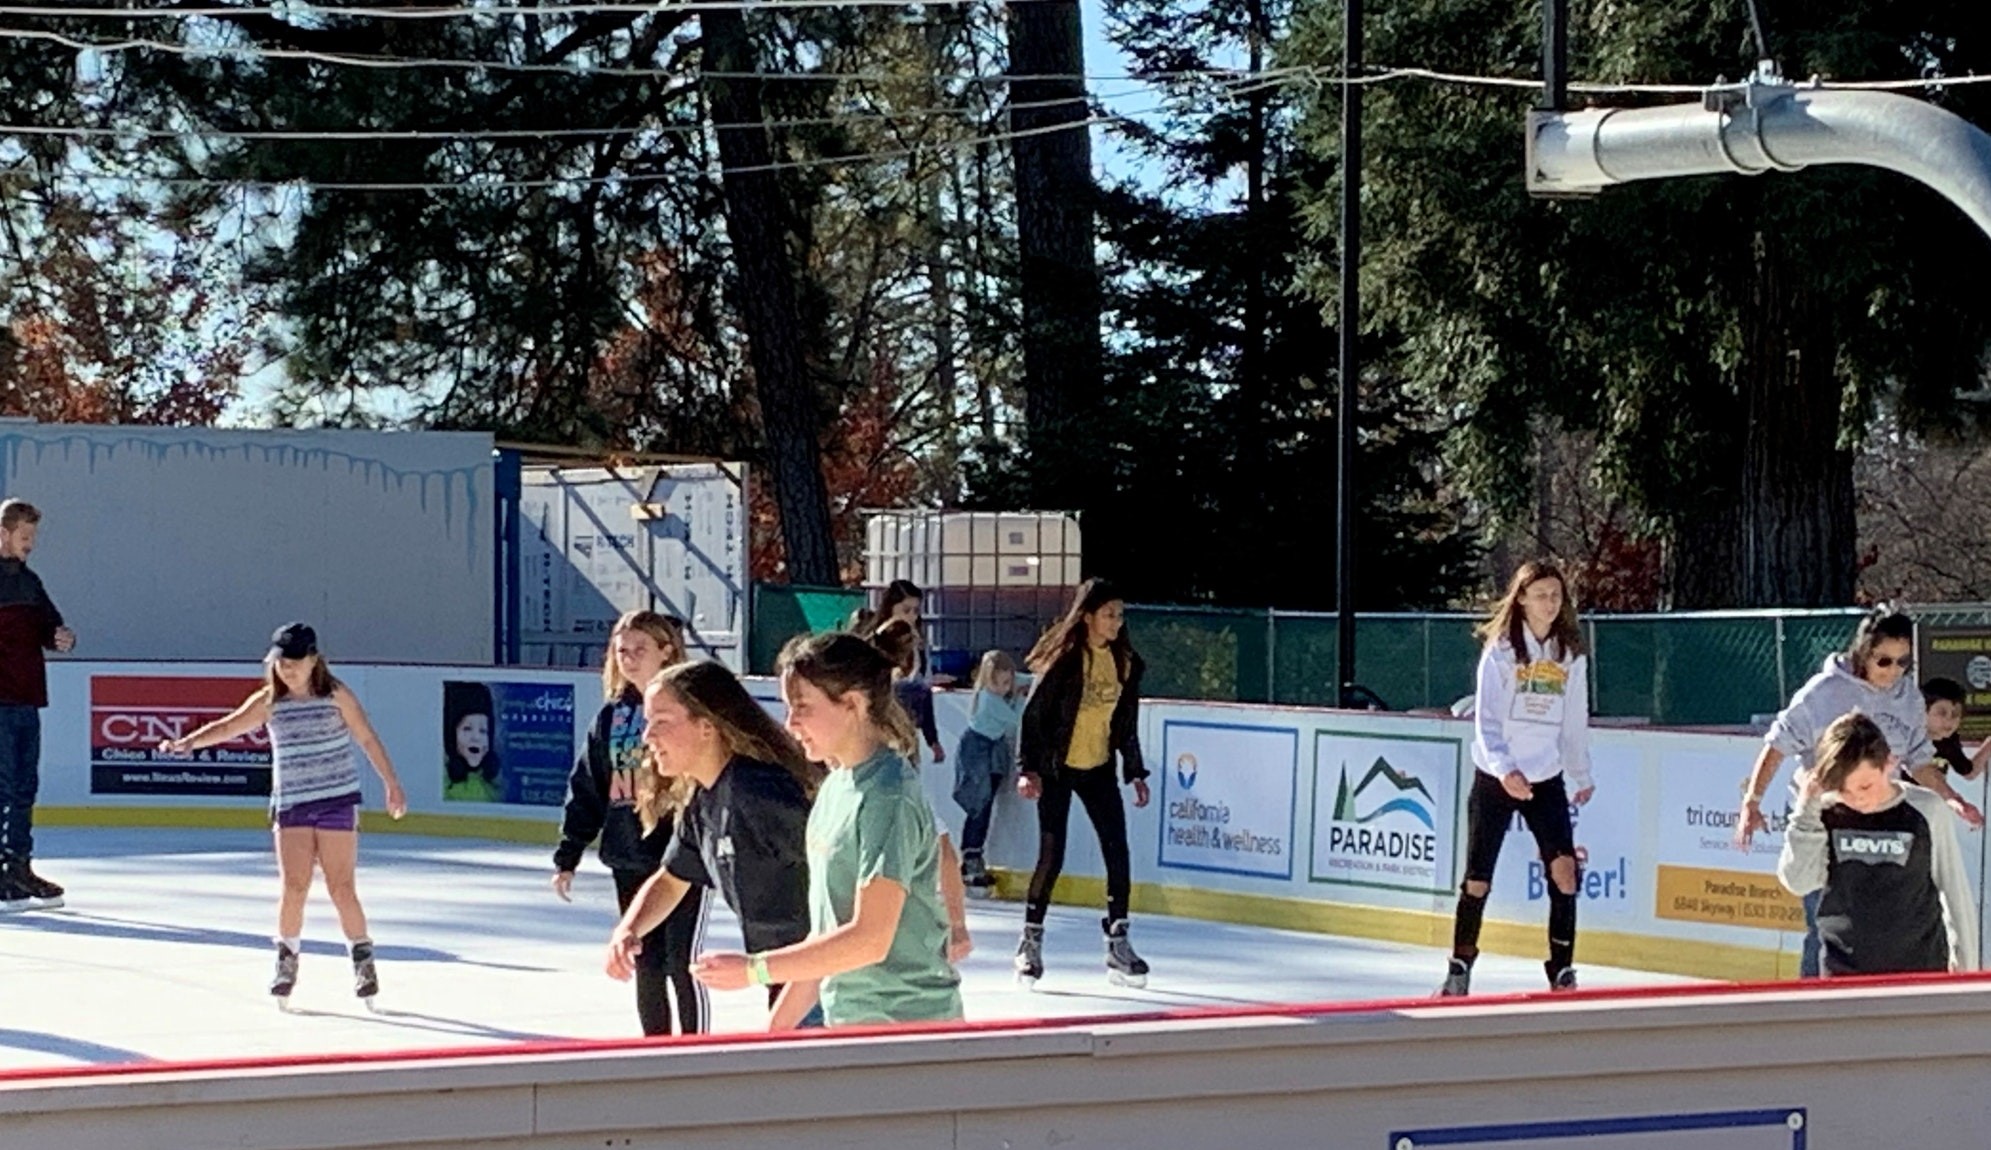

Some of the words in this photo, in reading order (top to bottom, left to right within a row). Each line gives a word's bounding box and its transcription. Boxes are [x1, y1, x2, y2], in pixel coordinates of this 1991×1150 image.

[101, 748, 147, 761] Chico
[198, 750, 212, 762] &
[216, 750, 270, 763] Review
[1169, 798, 1231, 824] california
[1168, 822, 1210, 849] health
[1223, 829, 1282, 855] wellness
[1330, 826, 1436, 862] PARADISE
[1528, 857, 1626, 900] Ber!
